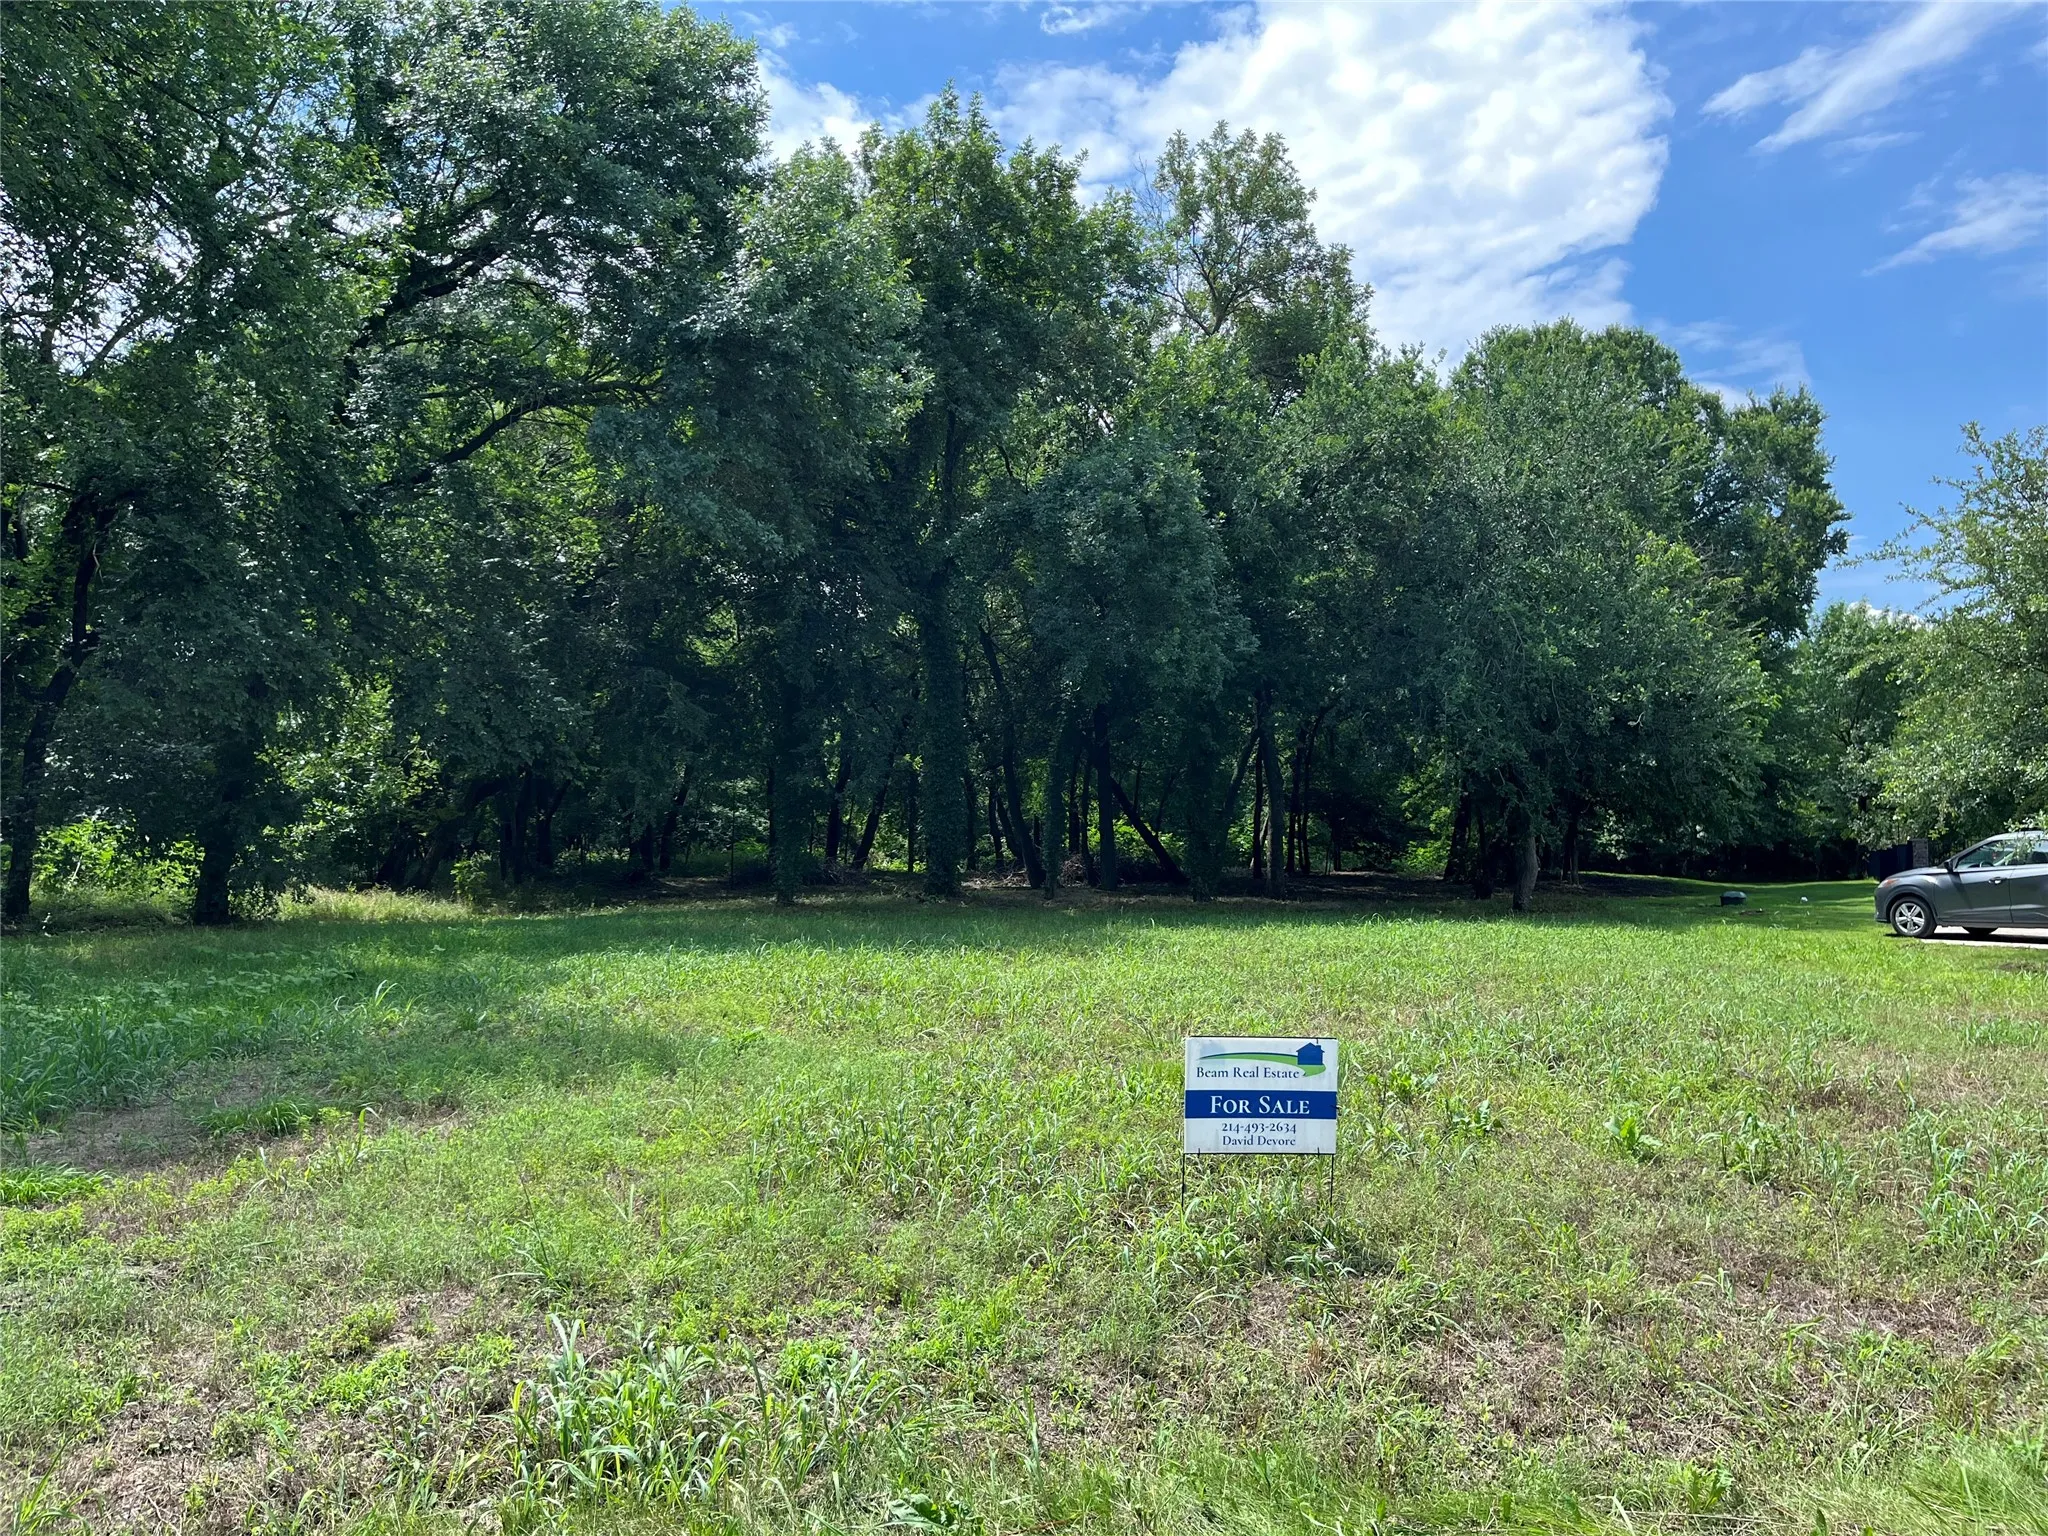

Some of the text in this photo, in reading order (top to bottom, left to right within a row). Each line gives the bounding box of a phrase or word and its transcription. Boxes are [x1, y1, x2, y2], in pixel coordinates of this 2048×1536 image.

[1196, 1066, 1299, 1079] Beam Real Estate
[1210, 1095, 1310, 1115] FOR SALE
[1222, 1122, 1296, 1134] 214-493-2634
[1222, 1135, 1296, 1146] David Devore
